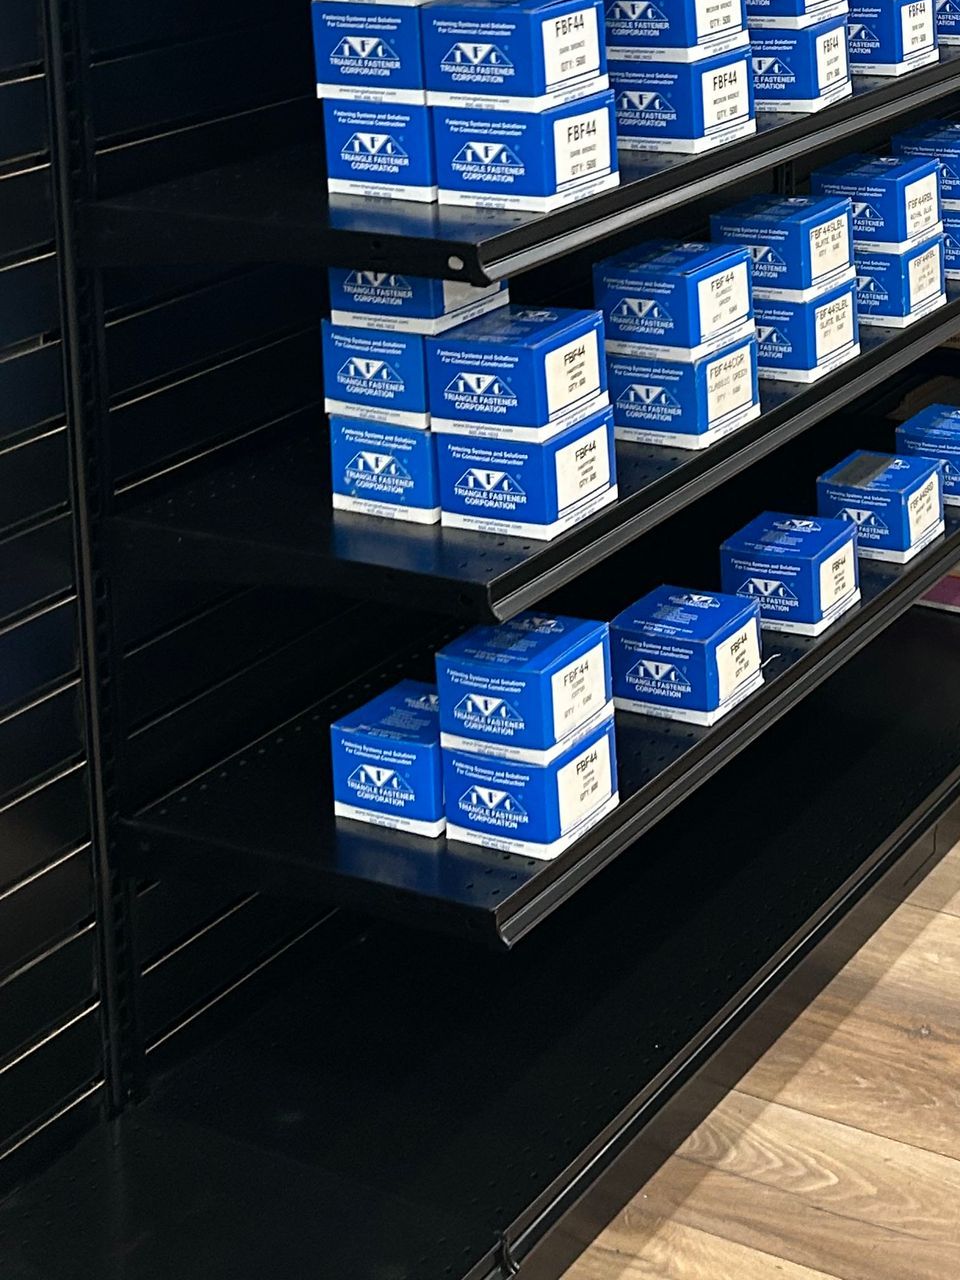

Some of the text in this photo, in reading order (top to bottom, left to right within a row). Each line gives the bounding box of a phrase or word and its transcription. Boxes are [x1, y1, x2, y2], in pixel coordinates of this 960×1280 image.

[554, 13, 585, 38] FBF44
[440, 64, 514, 76] TRIANGLE FASTENER
[451, 73, 504, 84] CORPORATION
[713, 70, 737, 91] FBF44
[567, 119, 597, 144] FBF44
[340, 154, 409, 166] TRIANGLE FASTENER
[351, 162, 399, 173] CORPORATION
[451, 163, 525, 176] TRIANGLE FASTENER
[462, 172, 514, 183] CORPORATION
[444, 393, 518, 406] TRIANGLE FASTENER
[455, 403, 507, 414] CORPORATION
[617, 402, 681, 416] TRIANGLE FASTENER
[625, 409, 672, 422] CORPORATION
[454, 488, 526, 504] TRIANGLE FASTENER
[465, 497, 516, 510] CORPORATION
[625, 676, 691, 693] TRIANGLE FASTENER
[635, 685, 681, 698] CORPORATION
[454, 711, 524, 730] TRIANGLE FASTENER
[464, 722, 514, 736] CORPORATION
